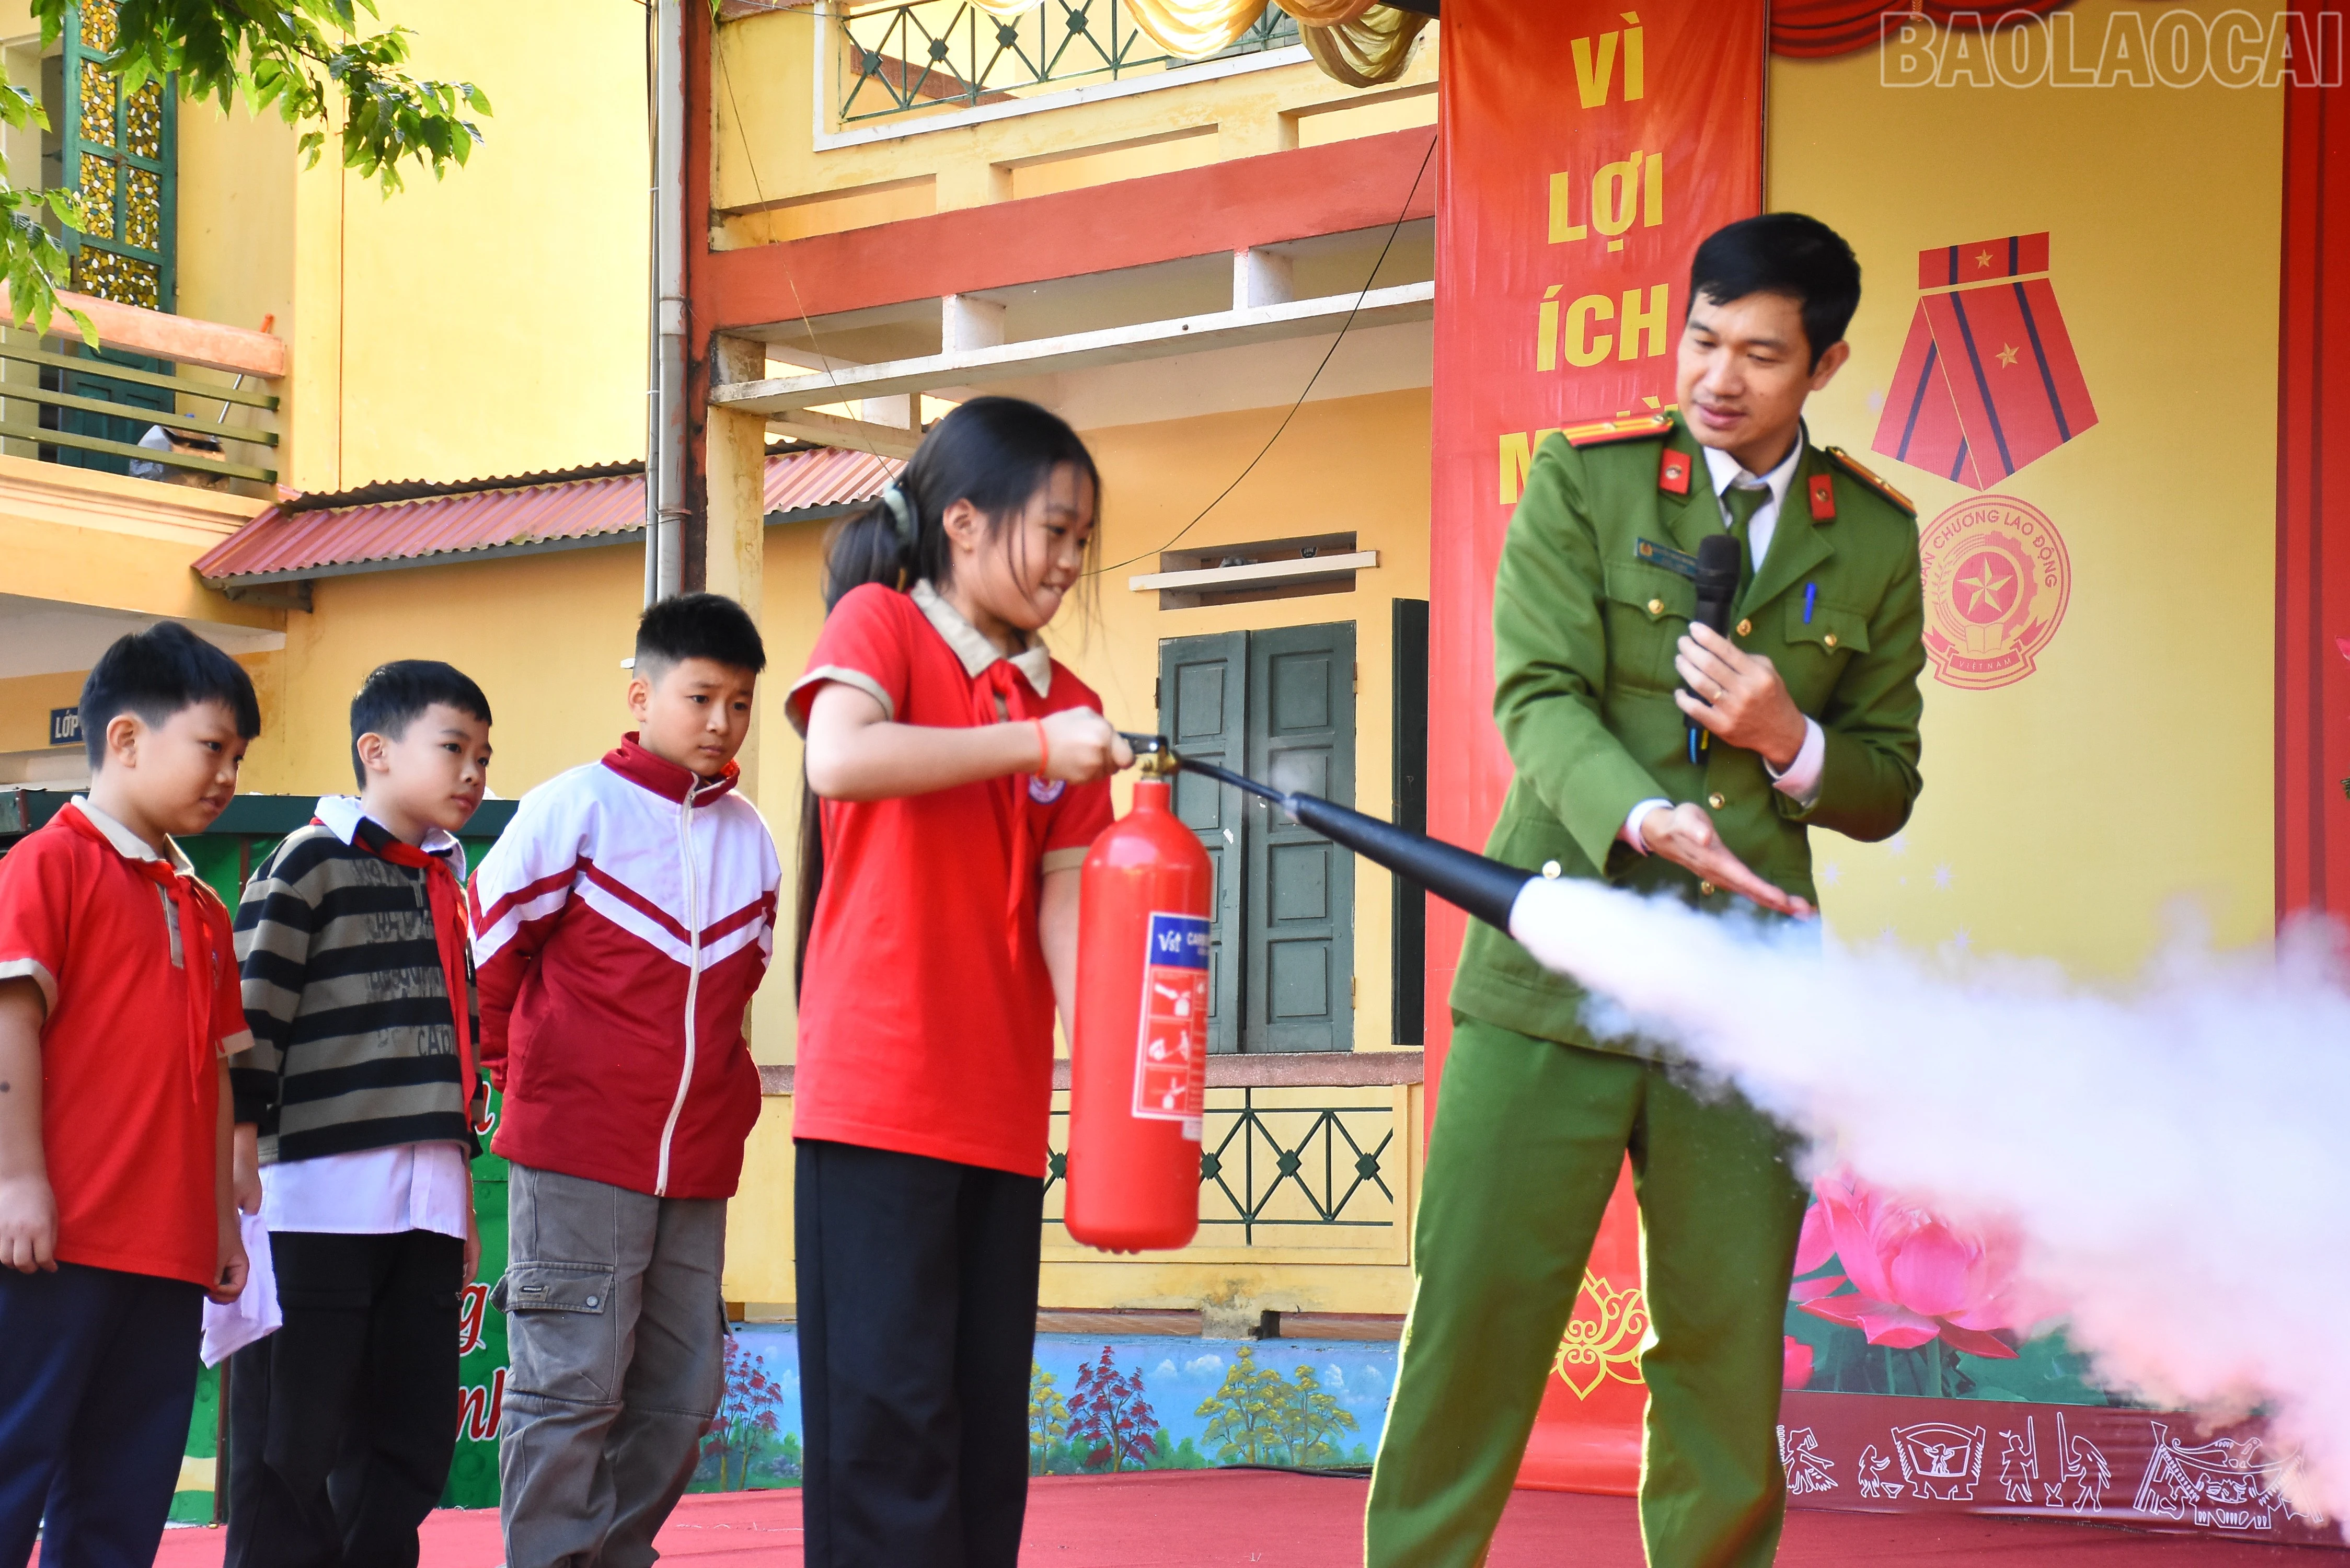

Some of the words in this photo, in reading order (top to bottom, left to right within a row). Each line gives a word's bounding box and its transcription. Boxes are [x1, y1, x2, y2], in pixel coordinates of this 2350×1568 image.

[1571, 13, 1644, 109] VÌ
[1548, 151, 1663, 252] LỢI
[1536, 283, 1669, 372] ÍCH
[1933, 510, 1999, 549] CHƯƠNG
[2004, 512, 2034, 536] LAO
[2032, 534, 2058, 589] ĐỘNG
[1988, 658, 2011, 670] NAM
[55, 710, 78, 739] LỚP
